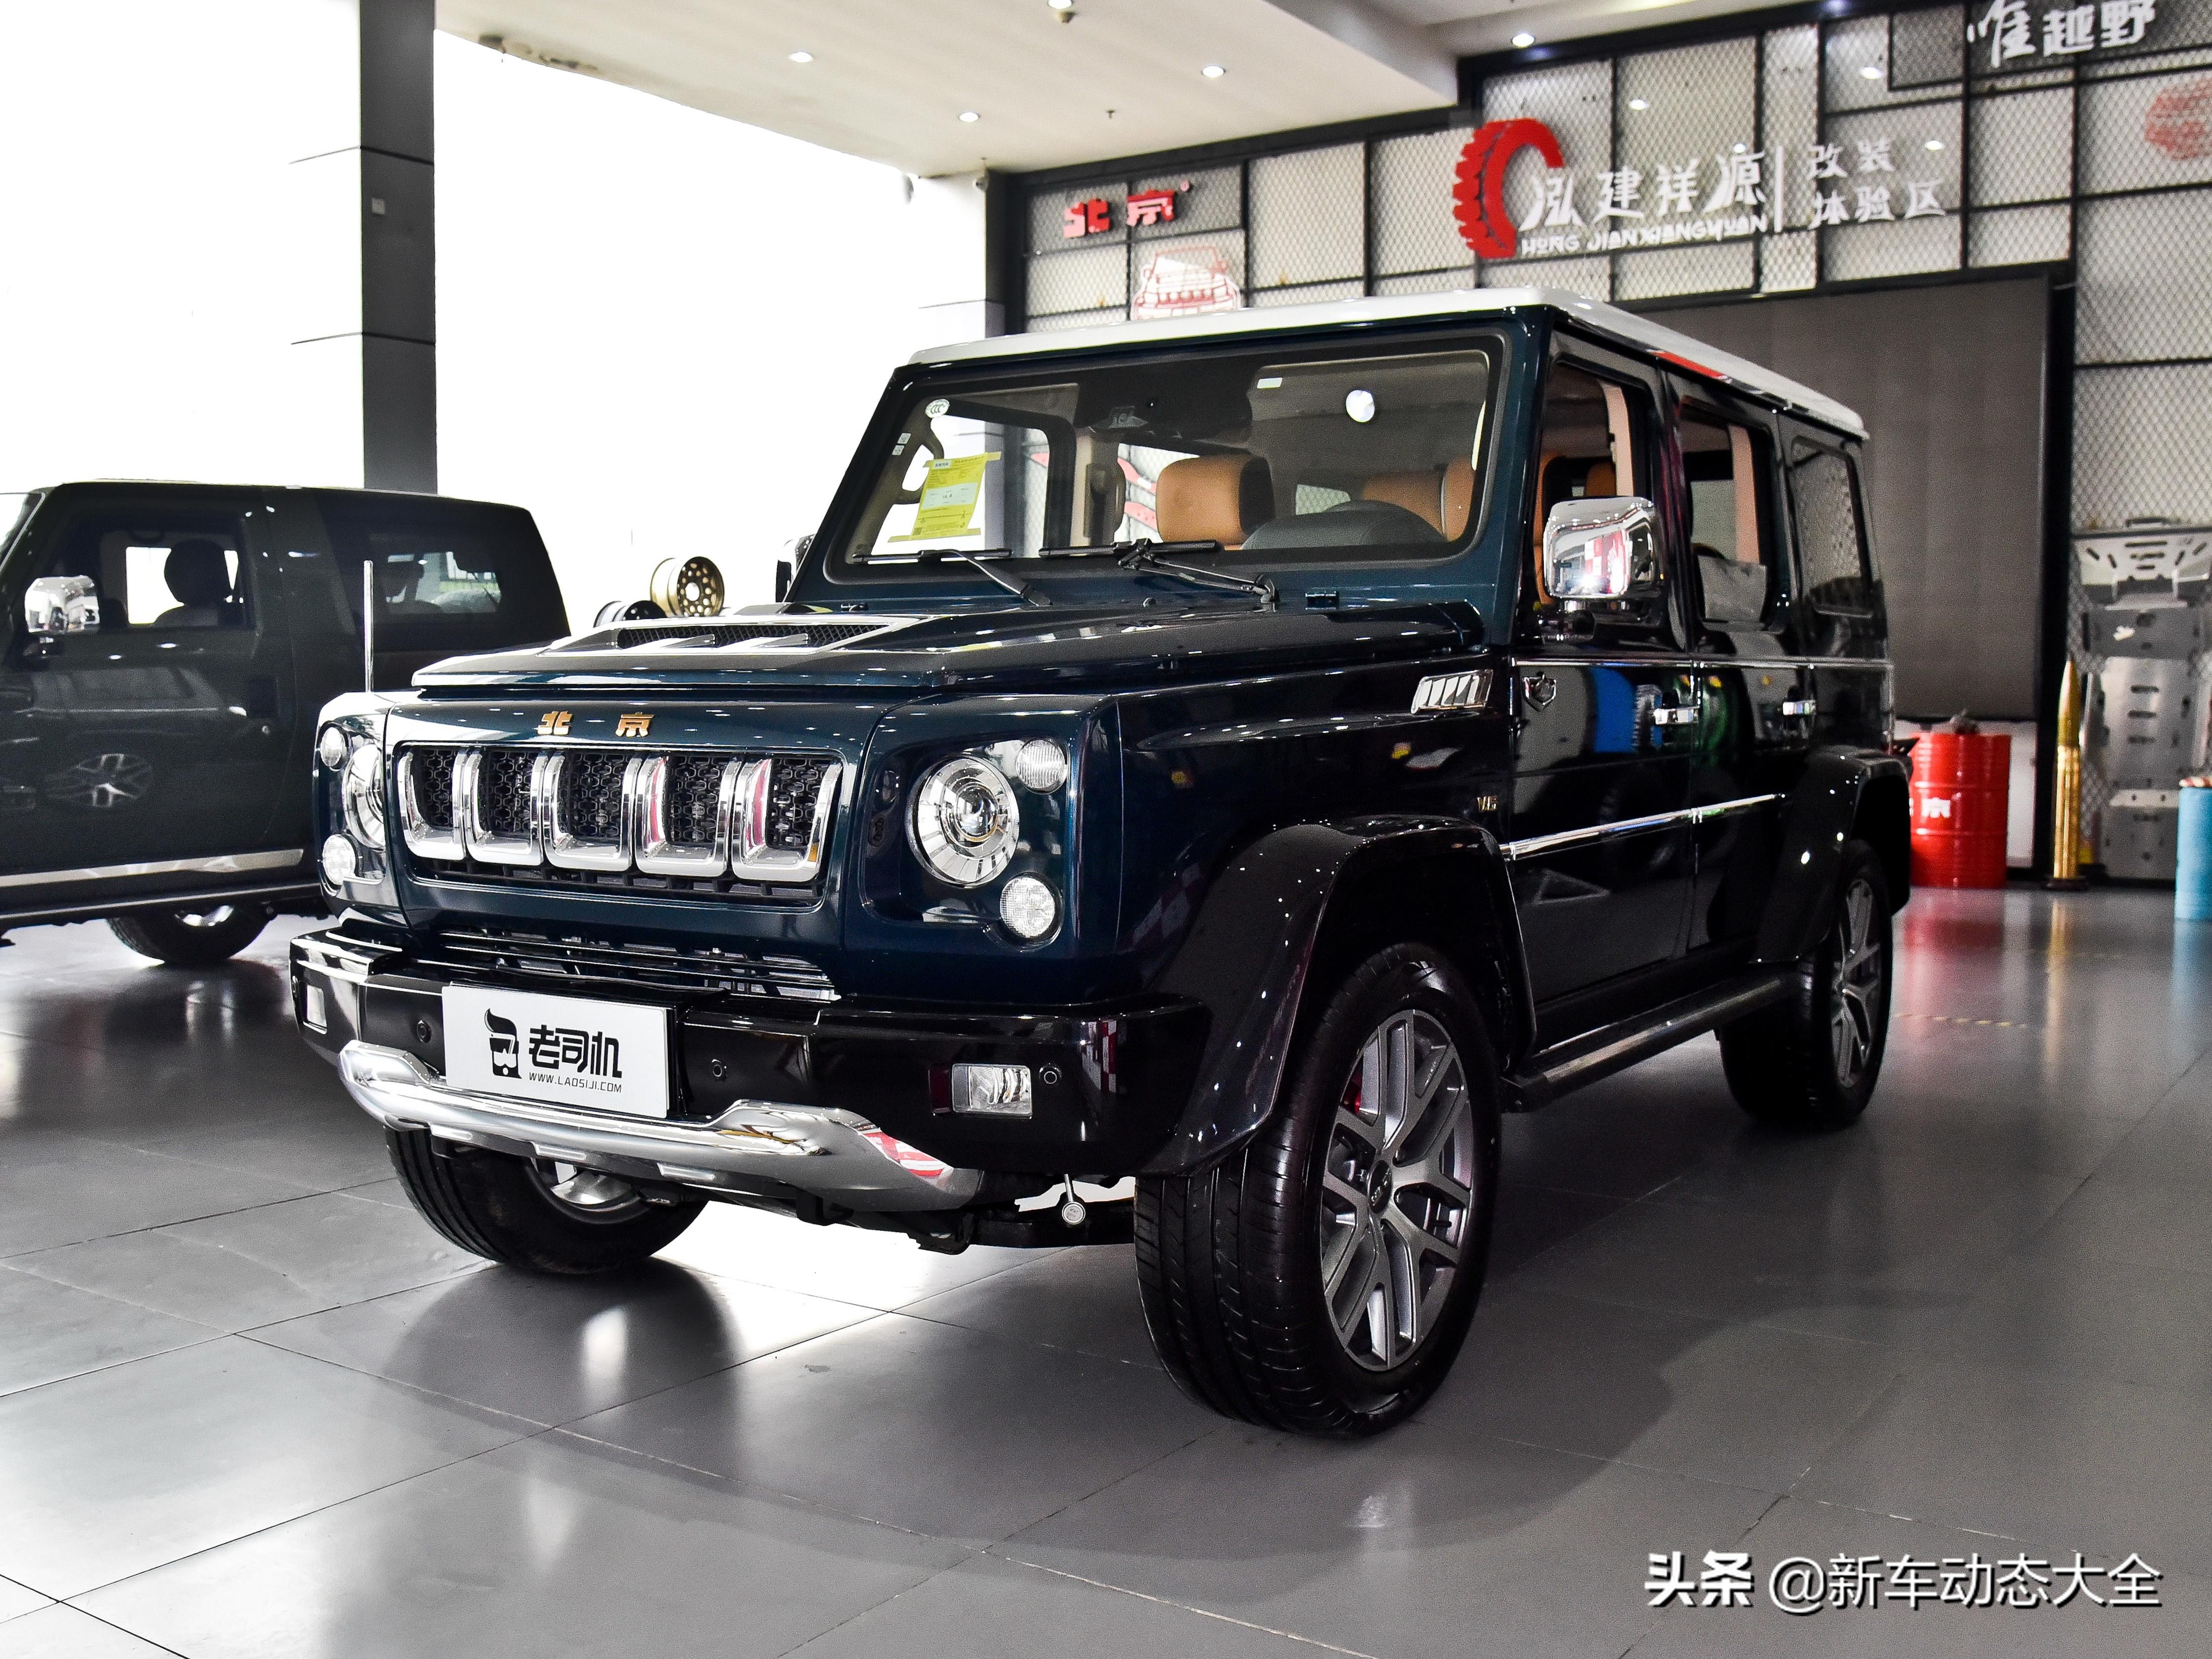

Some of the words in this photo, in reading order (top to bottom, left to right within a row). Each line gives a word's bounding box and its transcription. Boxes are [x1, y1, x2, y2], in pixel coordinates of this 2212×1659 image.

[1807, 137, 1896, 179] 改装
[1063, 189, 1176, 239] 北京
[1519, 150, 1767, 231] 泓建祥源
[1807, 177, 1946, 230] 体验区
[537, 711, 654, 737] 北京
[529, 1025, 622, 1078] 老司机
[529, 1072, 622, 1093] WWW.LAOSIJI.COM
